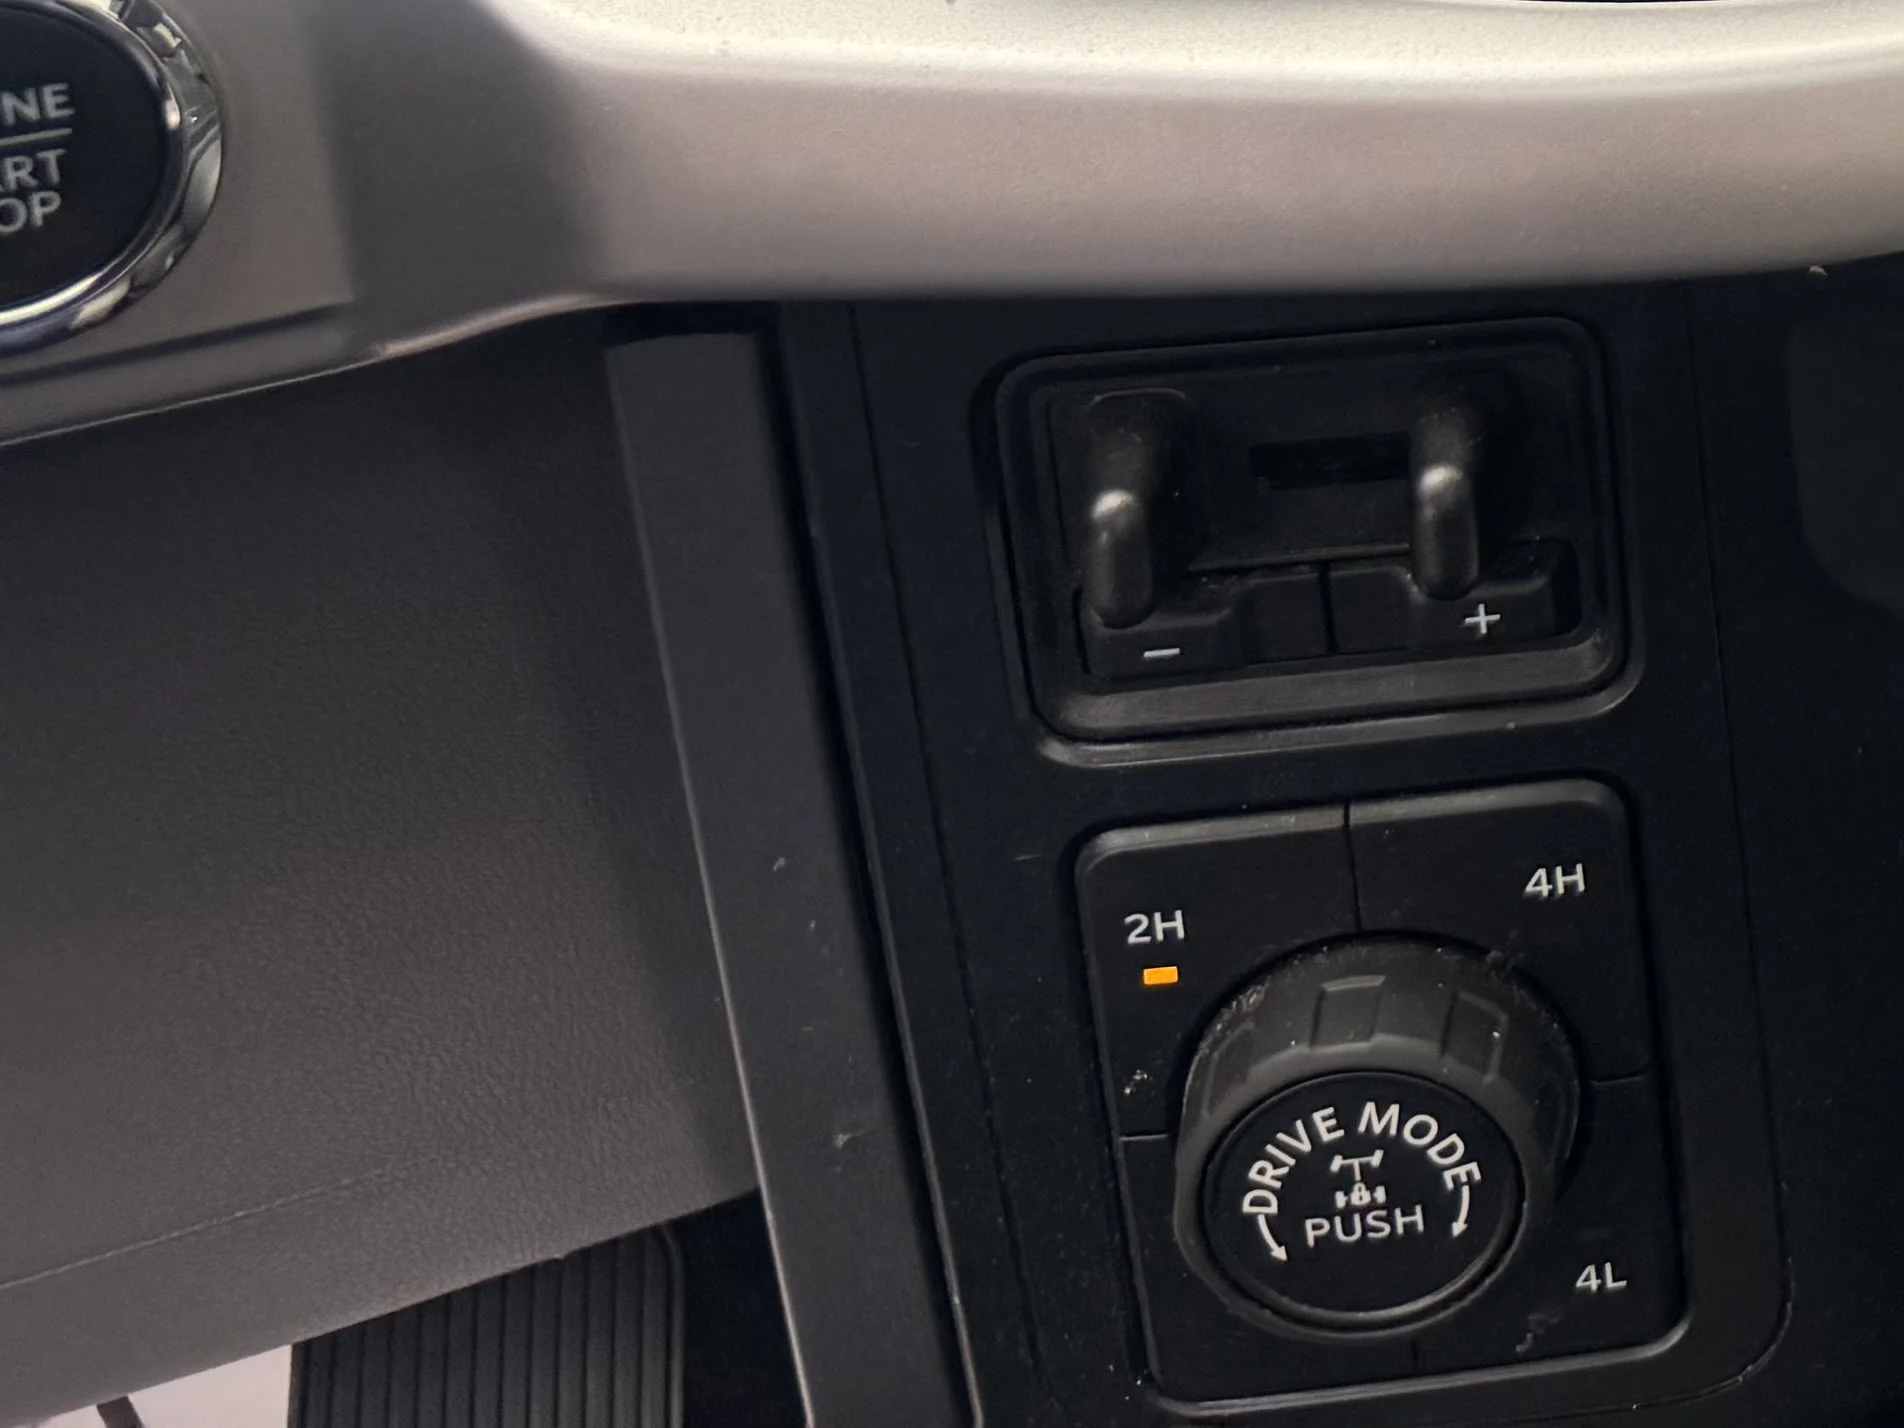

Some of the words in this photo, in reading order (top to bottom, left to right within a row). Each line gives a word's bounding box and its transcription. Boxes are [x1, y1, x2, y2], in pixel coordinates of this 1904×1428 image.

[1525, 863, 1586, 899] 4H
[1124, 909, 1185, 946] 2H
[1241, 1106, 1346, 1216] DRIVE
[1357, 1101, 1482, 1190] MODE
[1304, 1204, 1424, 1248] PUSH
[1575, 1261, 1628, 1293] 4L
